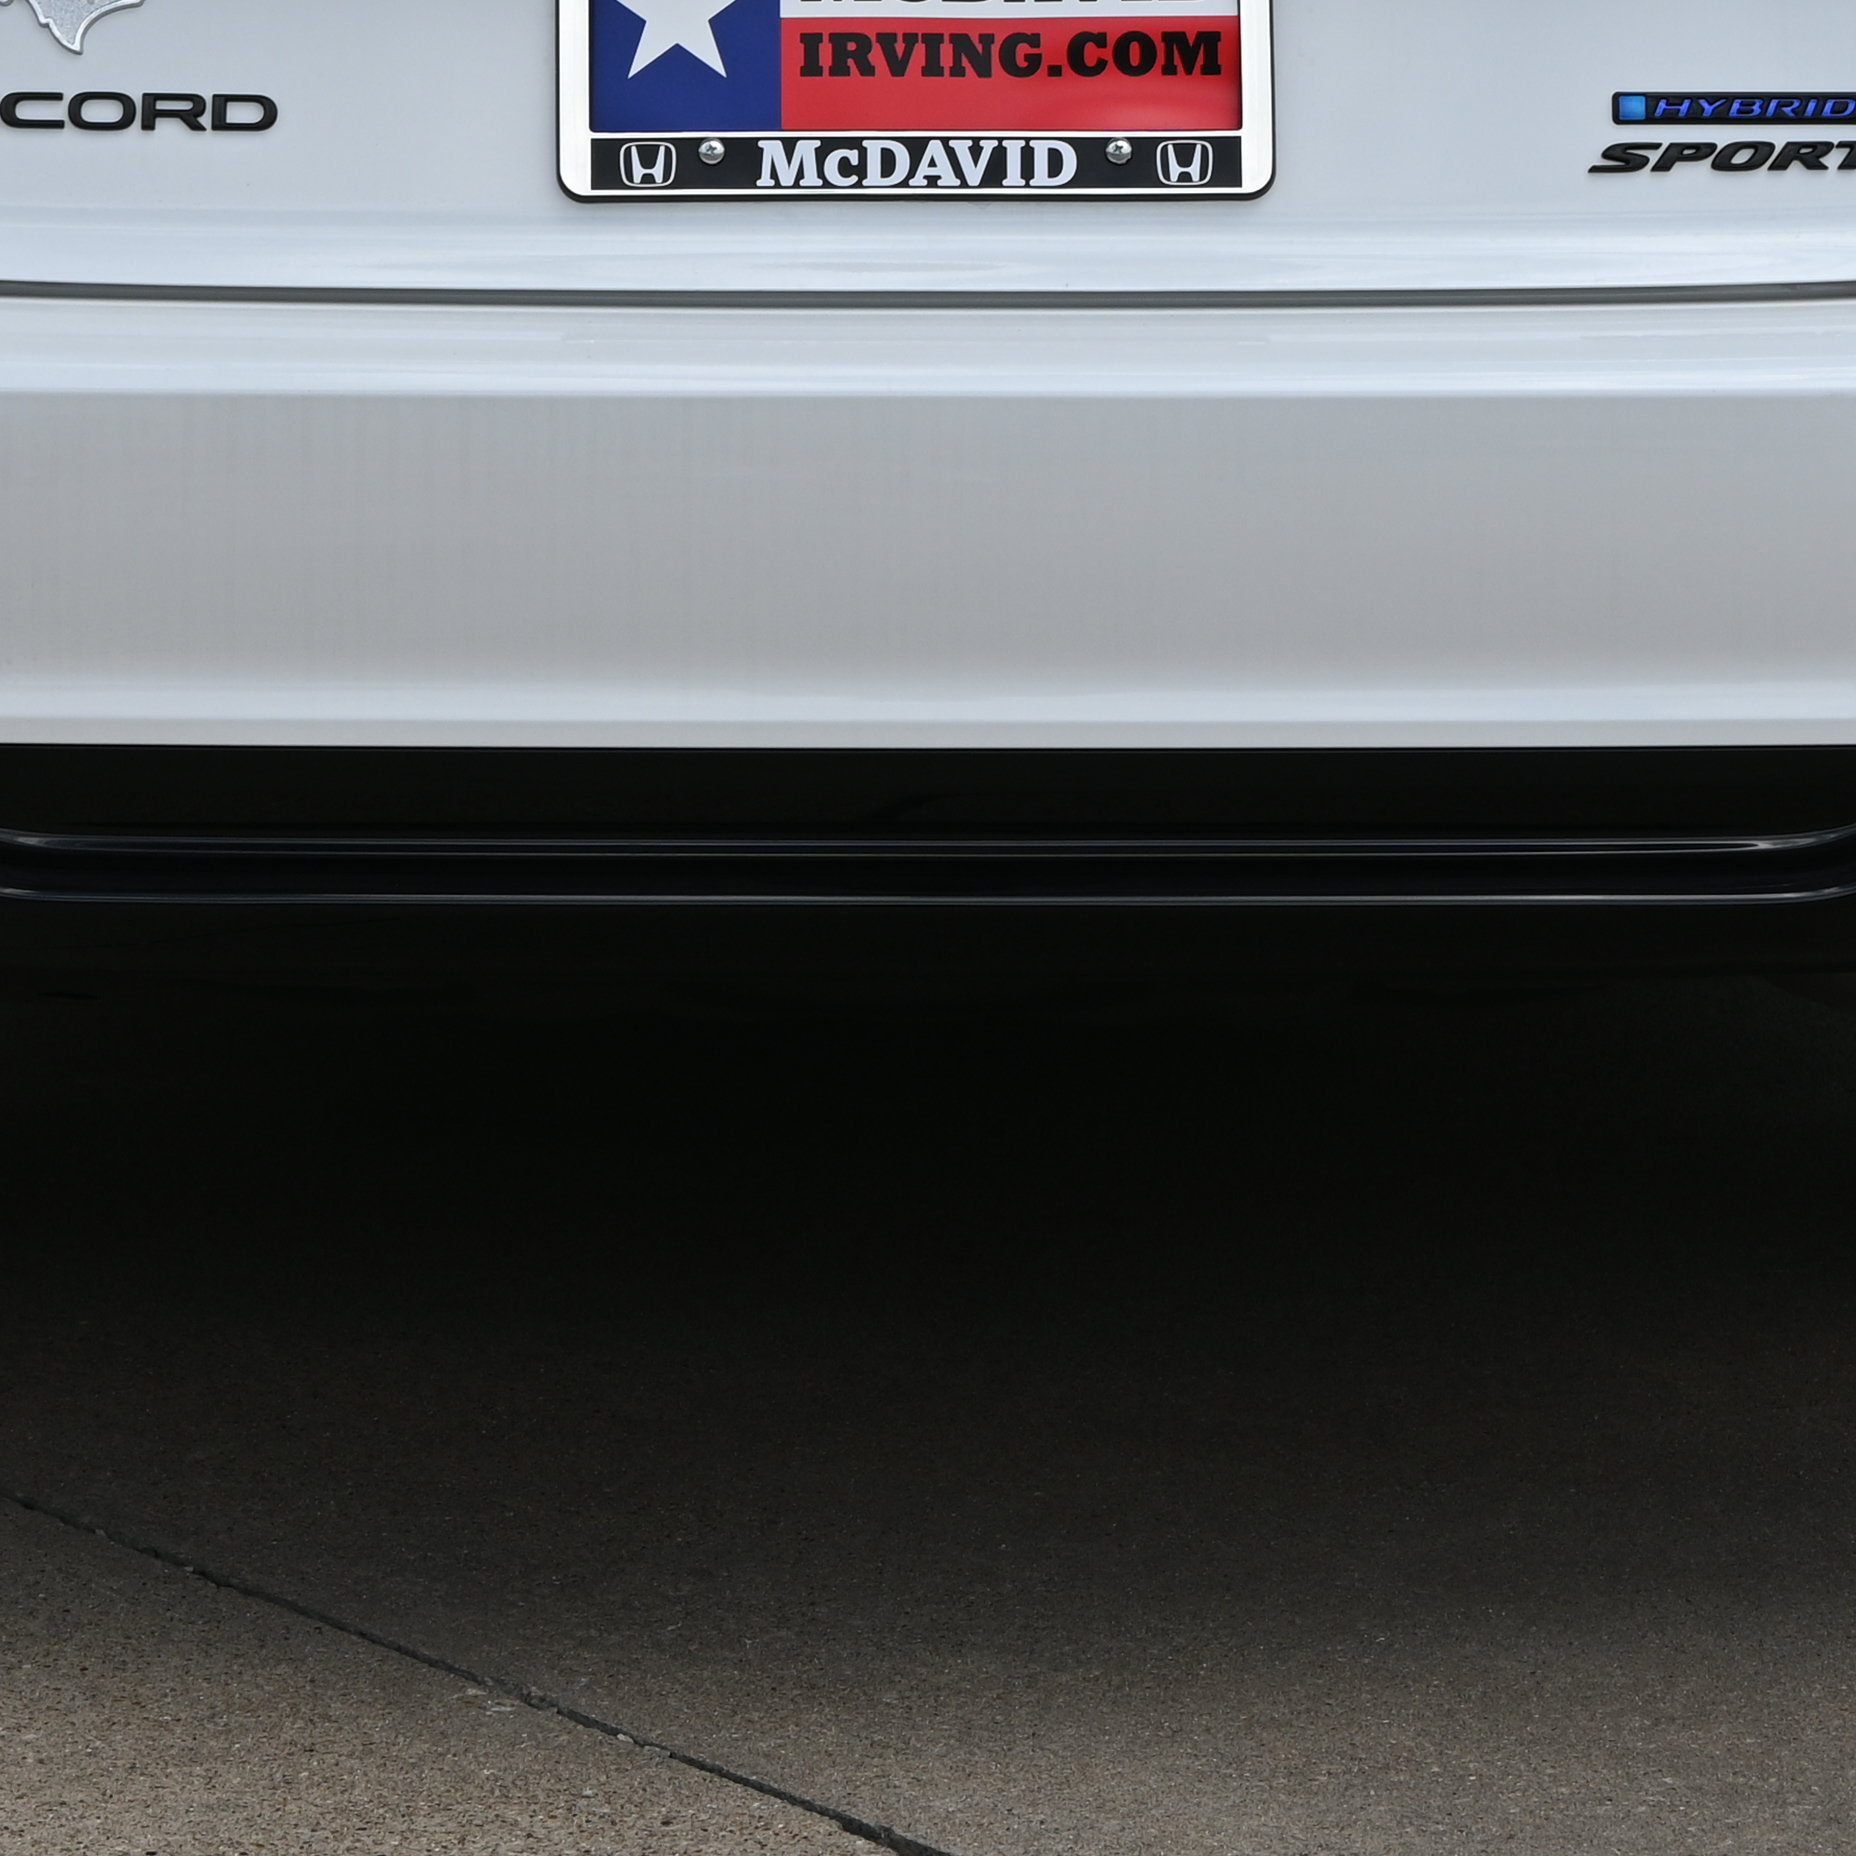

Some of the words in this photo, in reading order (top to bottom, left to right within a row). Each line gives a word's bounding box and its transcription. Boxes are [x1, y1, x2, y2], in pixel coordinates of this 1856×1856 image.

[799, 30, 1222, 78] IRVING.COM
[1654, 98, 1856, 118] HYBRID
[756, 139, 1079, 187] McDAVID
